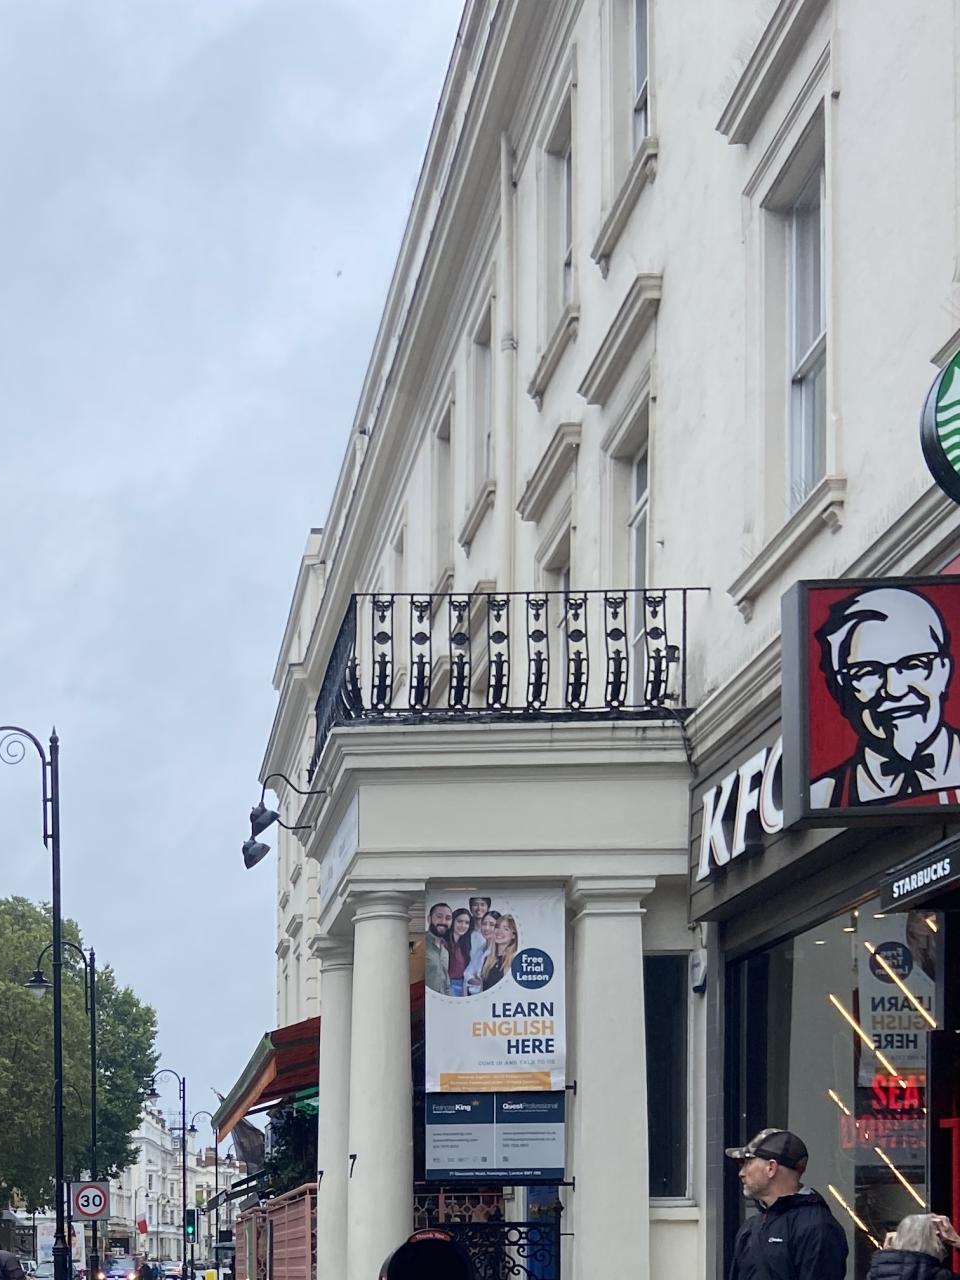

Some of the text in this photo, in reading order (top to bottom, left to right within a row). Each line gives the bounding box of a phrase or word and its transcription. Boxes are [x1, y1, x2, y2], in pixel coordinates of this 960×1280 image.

[696, 734, 783, 882] KFC
[892, 858, 951, 898] STARBUCKS
[521, 954, 543, 964] Free
[521, 963, 544, 972] Trial
[516, 972, 549, 981] Lesson
[492, 1001, 554, 1018] LEARN
[472, 1020, 555, 1038] ENGLISH
[507, 1038, 555, 1055] HERE
[349, 1154, 357, 1178] 7
[318, 1170, 324, 1191] 7
[81, 1194, 103, 1208] 30
